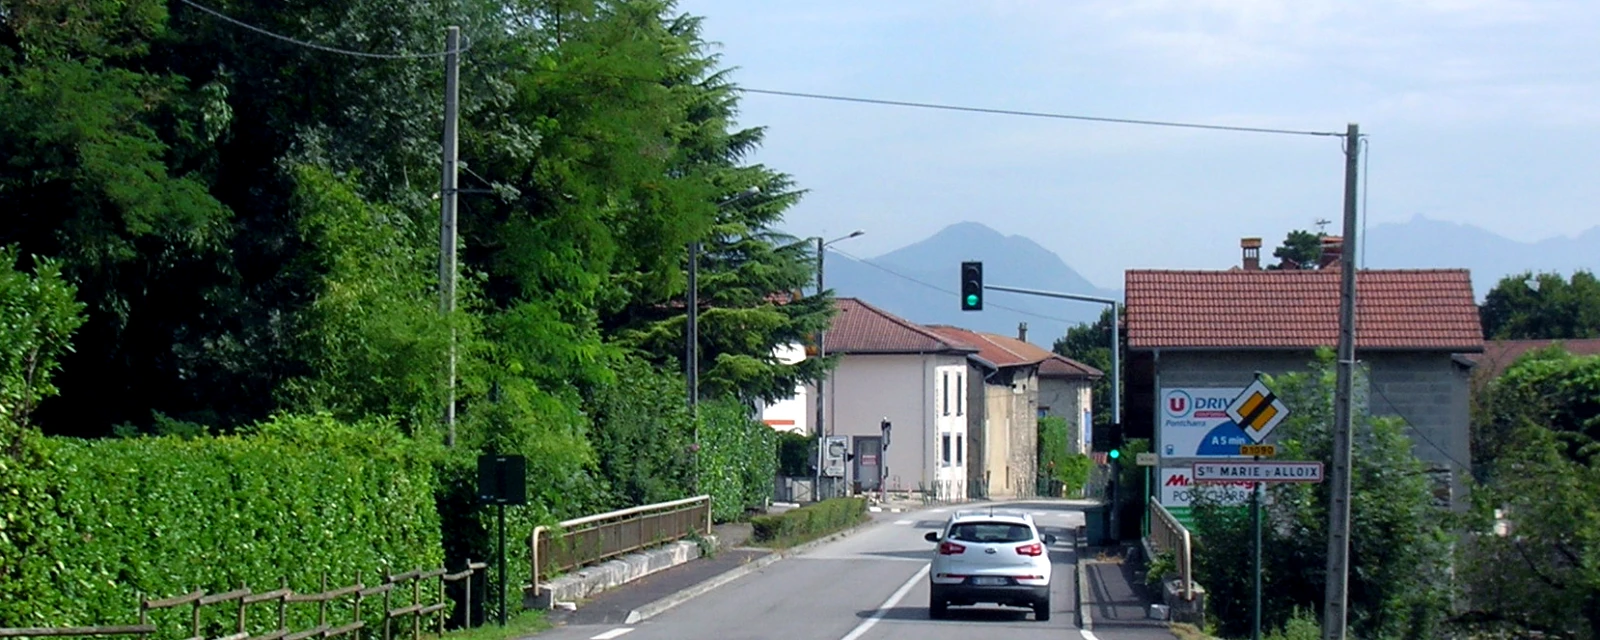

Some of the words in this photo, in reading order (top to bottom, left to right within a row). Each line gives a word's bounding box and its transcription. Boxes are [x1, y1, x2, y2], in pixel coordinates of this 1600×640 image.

[1170, 398, 1185, 412] U
[1195, 397, 1236, 409] DRIV
[1221, 436, 1227, 445] 5
[1228, 436, 1246, 445] min
[1241, 446, 1275, 456] D1090
[1220, 467, 1260, 477] MARIE
